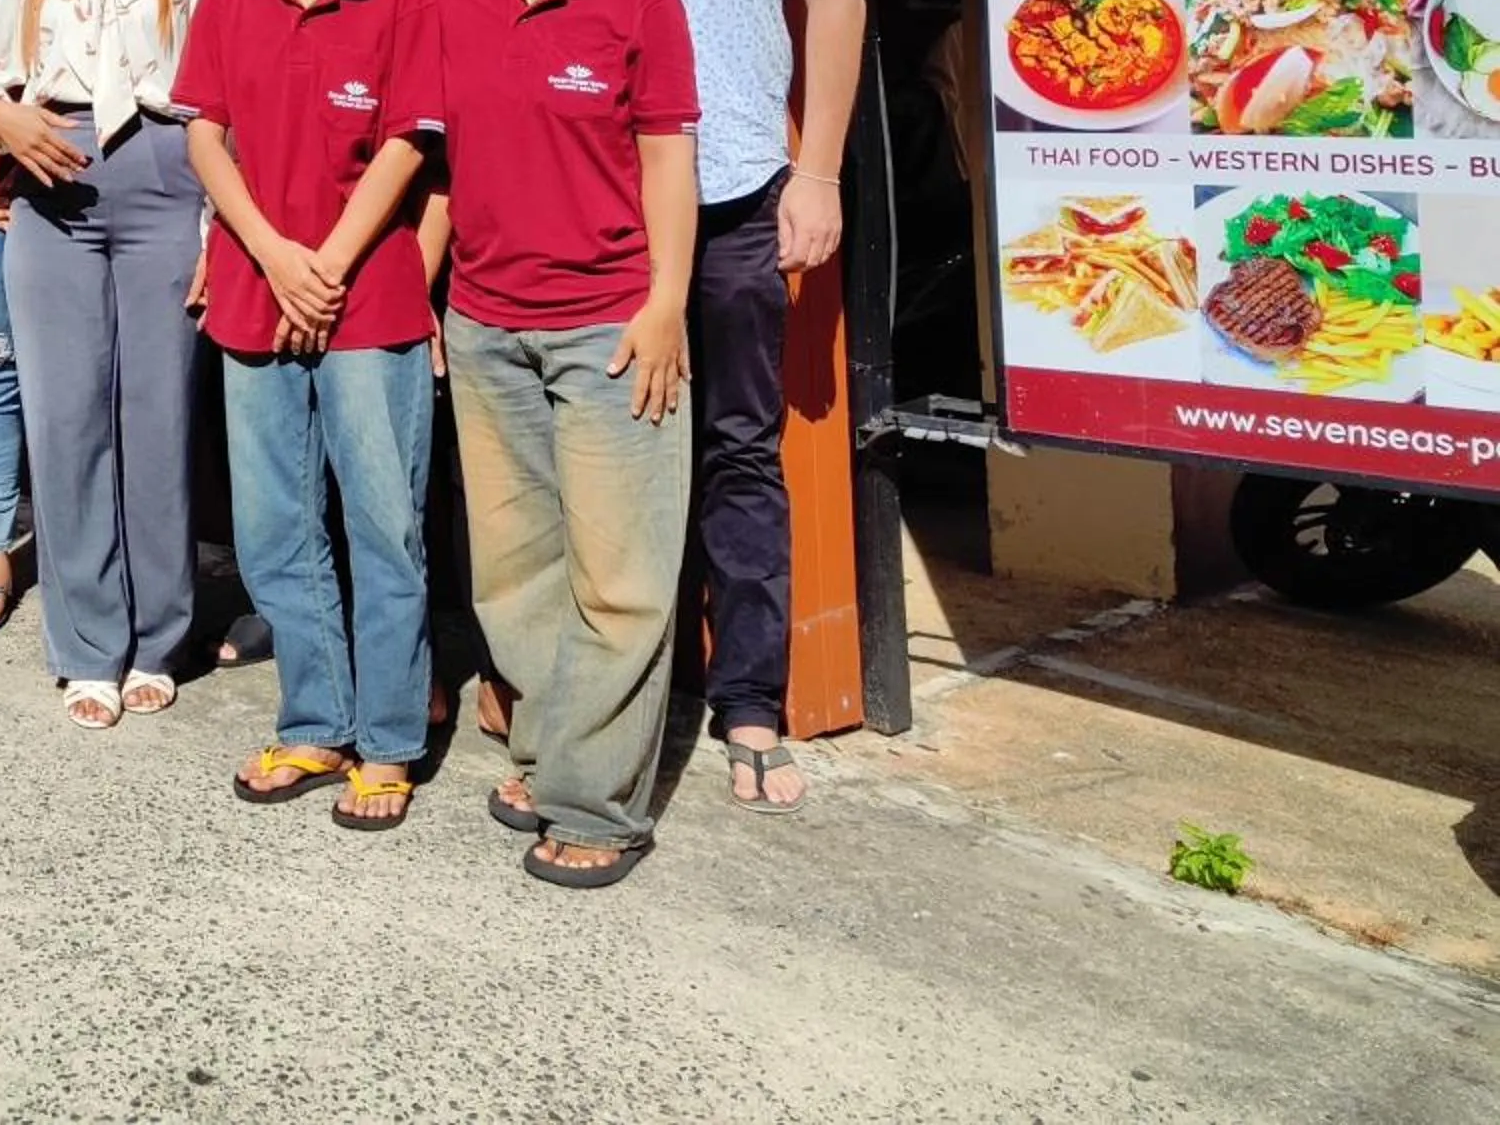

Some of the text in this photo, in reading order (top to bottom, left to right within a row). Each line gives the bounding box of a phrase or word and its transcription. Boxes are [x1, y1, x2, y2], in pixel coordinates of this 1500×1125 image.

[1028, 146, 1080, 168] THAI
[1088, 146, 1160, 169] FOOD
[1188, 149, 1321, 173] WESTERN
[1330, 153, 1435, 176] DISHES
